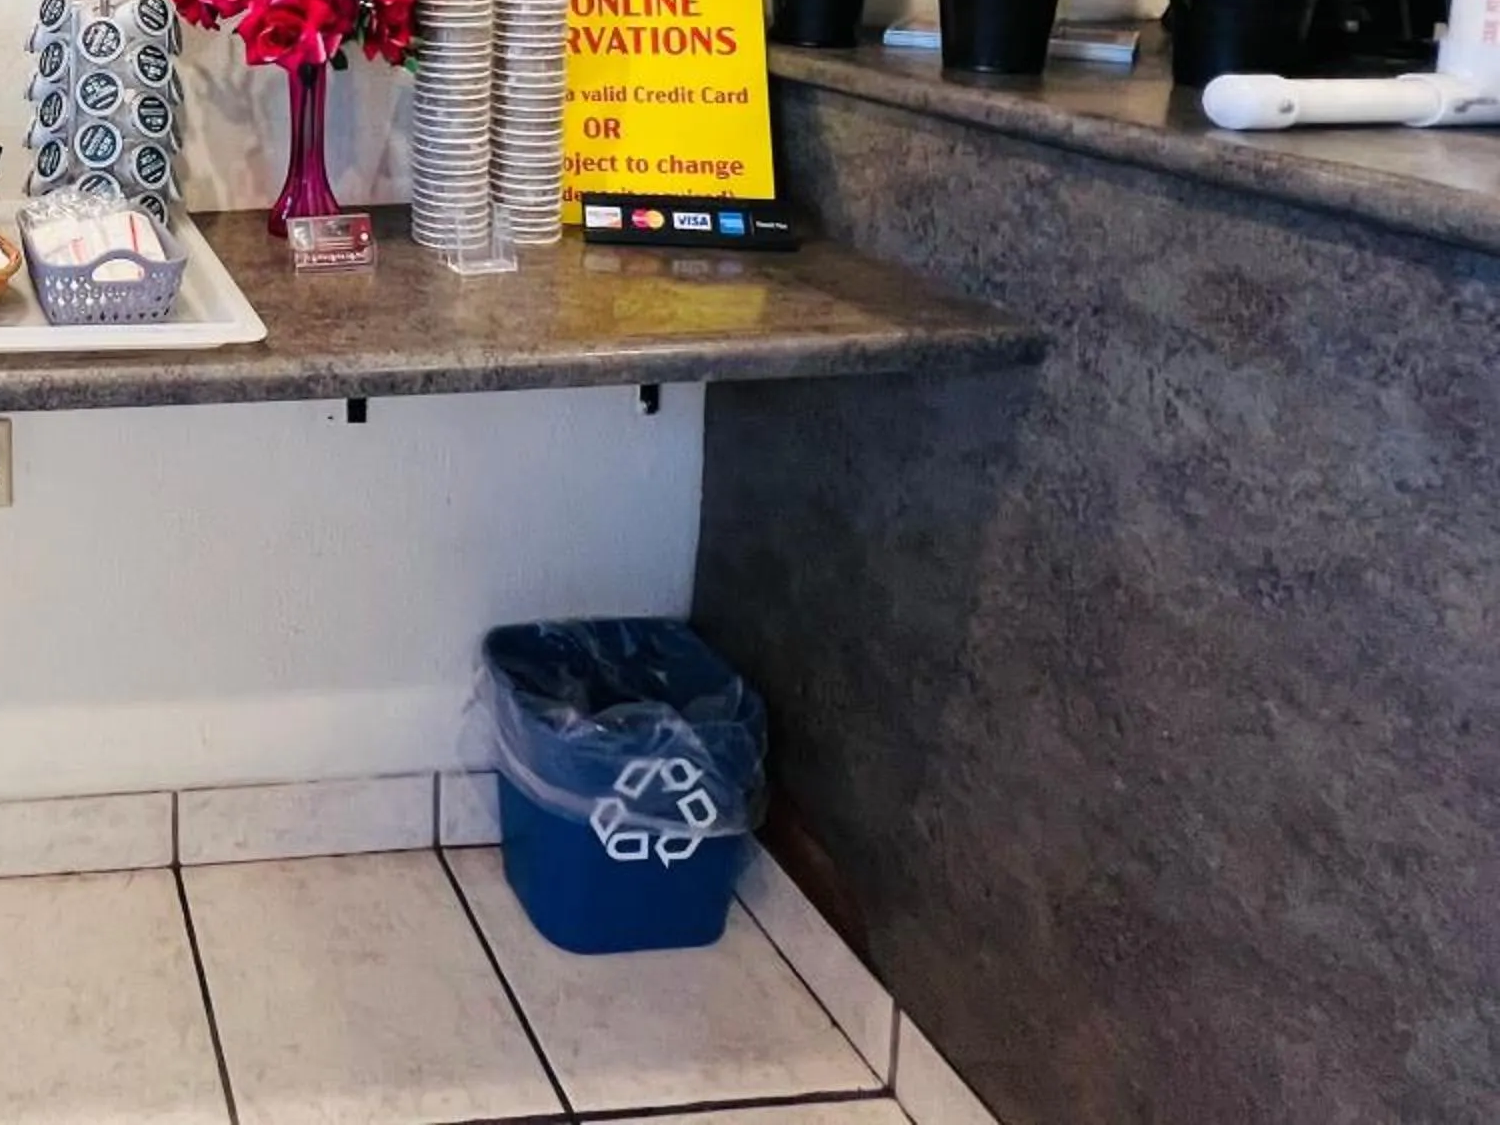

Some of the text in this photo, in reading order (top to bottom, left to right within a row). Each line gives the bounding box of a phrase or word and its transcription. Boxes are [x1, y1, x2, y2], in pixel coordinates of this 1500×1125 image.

[581, 86, 627, 103] valid
[633, 86, 694, 104] Credit
[701, 86, 749, 104] Card
[583, 117, 621, 139] OR
[626, 156, 649, 173] to
[656, 154, 745, 179] change
[678, 216, 709, 227] VISA
